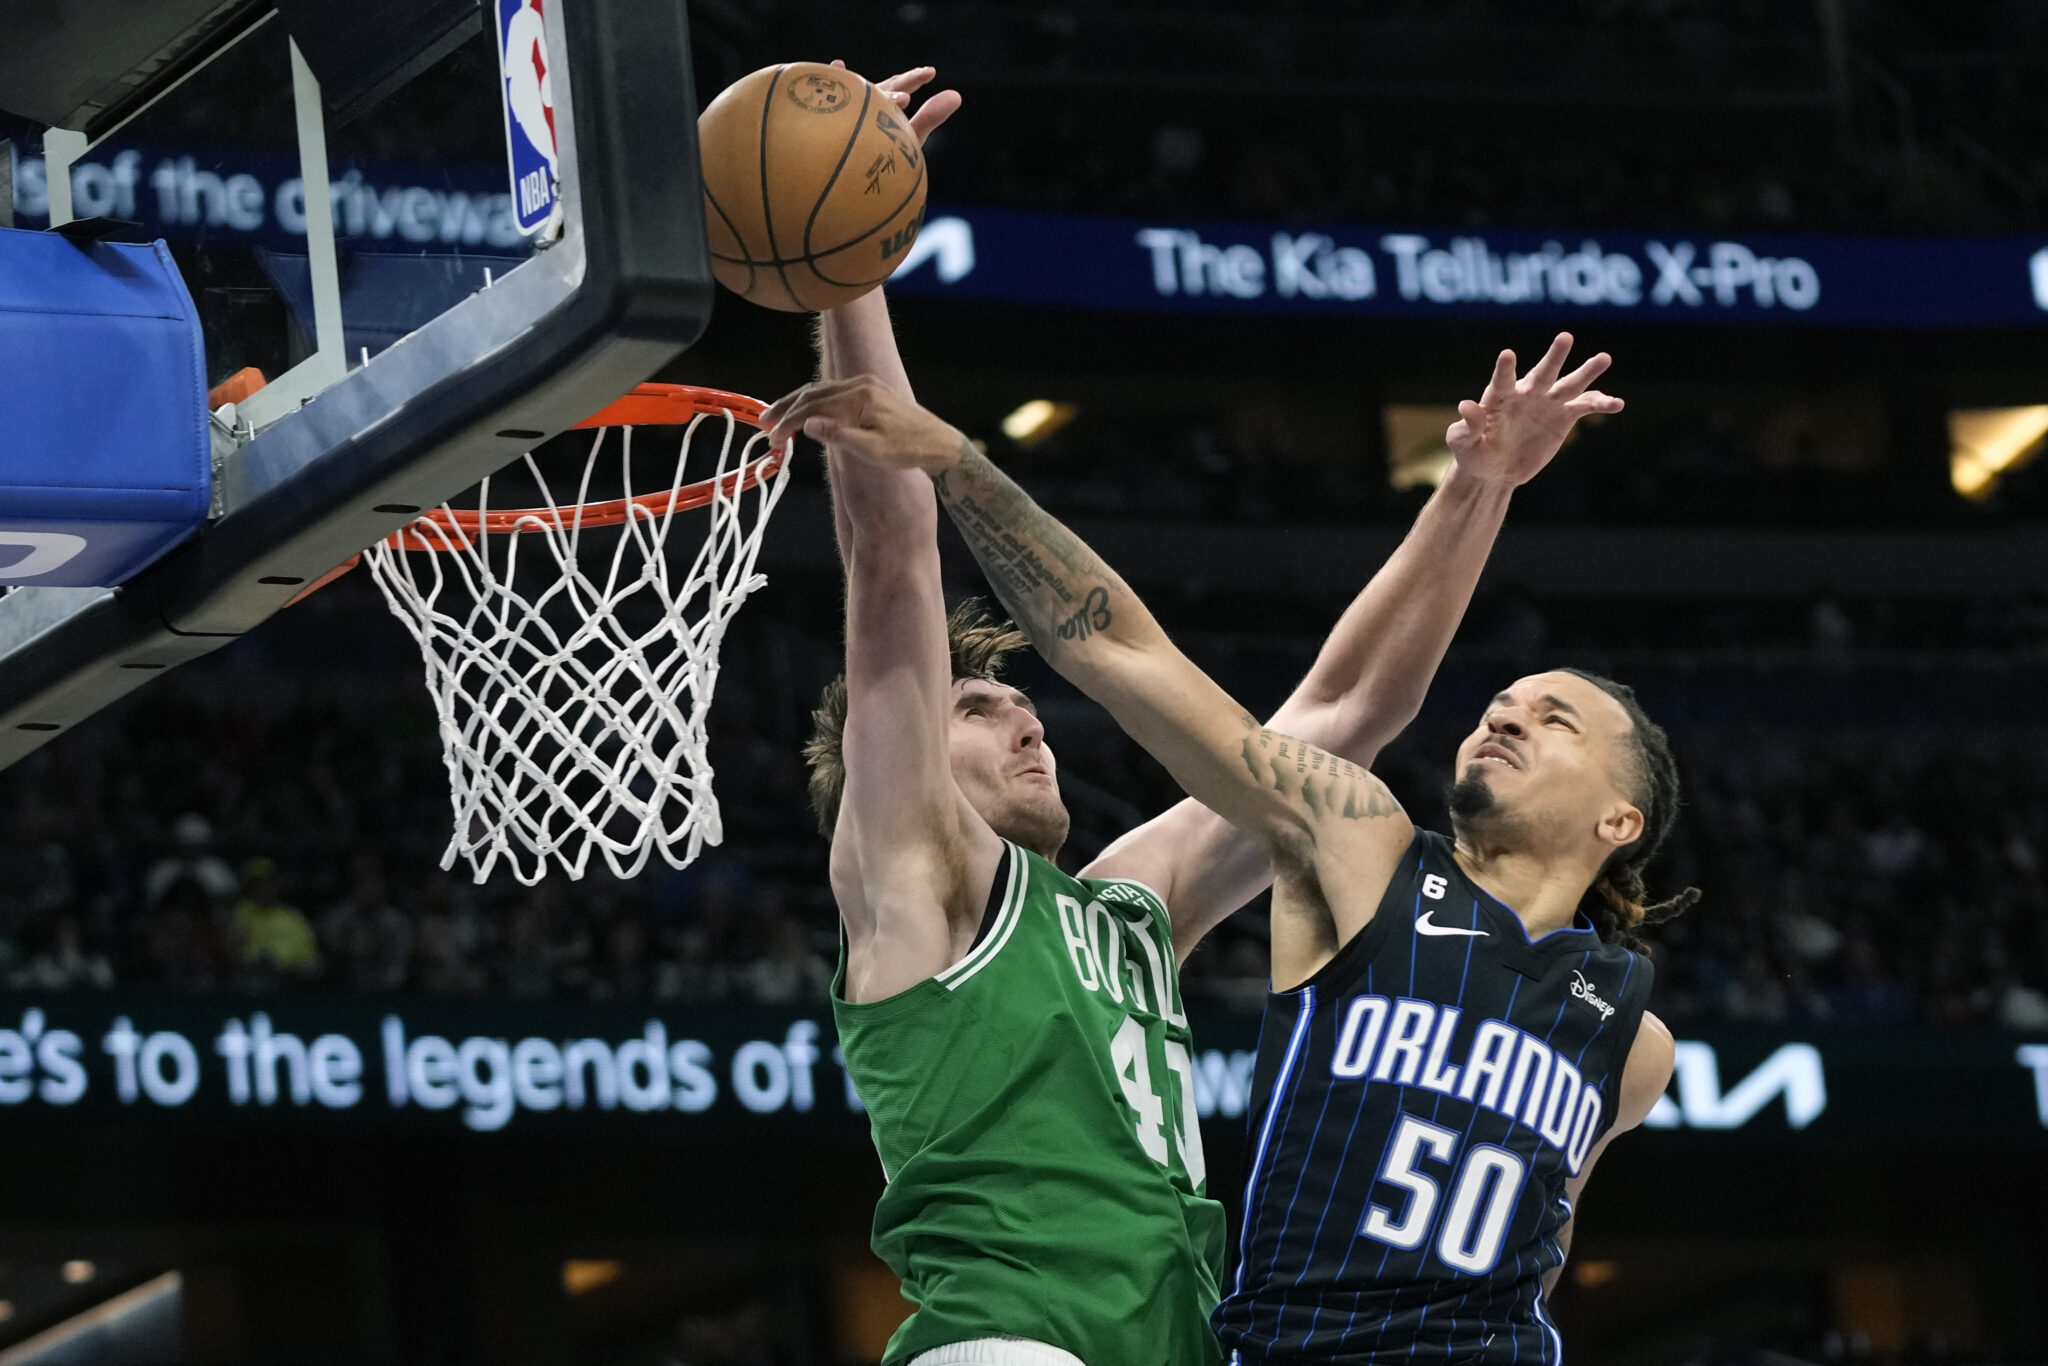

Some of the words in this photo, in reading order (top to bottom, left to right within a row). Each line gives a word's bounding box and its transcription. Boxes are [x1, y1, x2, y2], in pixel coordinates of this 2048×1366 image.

[72, 150, 142, 220] of
[149, 156, 265, 231] the
[520, 166, 550, 218] NBA
[1135, 227, 1265, 299] The
[1270, 231, 1377, 300] Kia
[1380, 234, 1642, 306] Telluride
[1644, 240, 1820, 310] X-Pro
[1422, 873, 1449, 900] 6
[1570, 969, 1616, 1022] Disney
[103, 1013, 199, 1106] to
[214, 1010, 363, 1109] the
[381, 1013, 716, 1132] legends
[732, 1019, 819, 1114] of
[1331, 994, 1602, 1177] ORLANDO
[1358, 1110, 1526, 1276] 50
